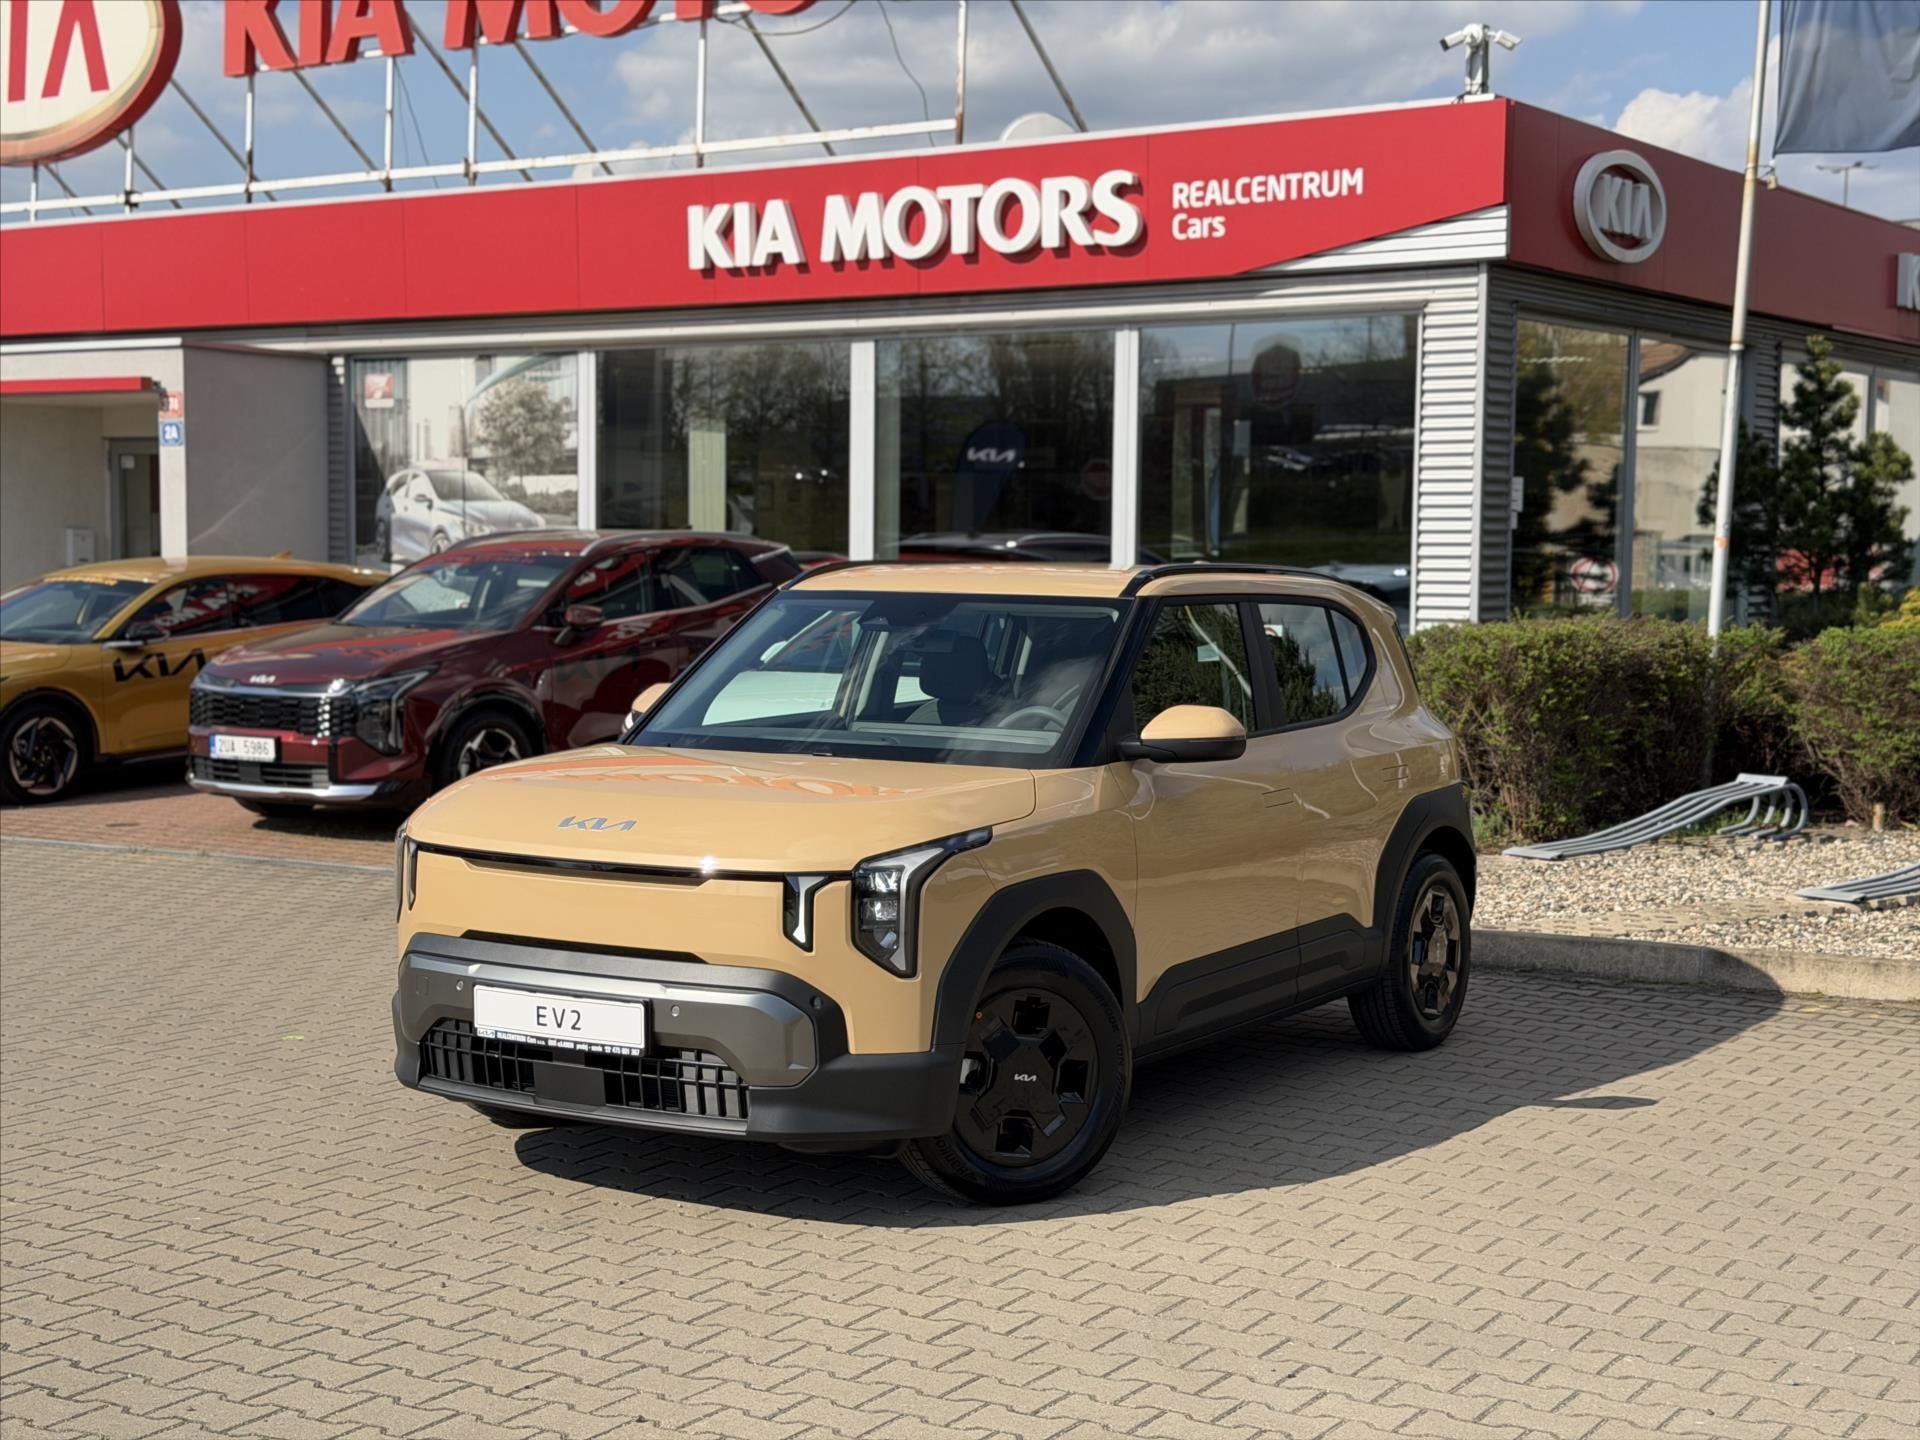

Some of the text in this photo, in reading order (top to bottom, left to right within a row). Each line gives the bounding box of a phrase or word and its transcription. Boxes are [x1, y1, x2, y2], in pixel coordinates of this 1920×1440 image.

[8, 0, 110, 103] IA
[223, 0, 414, 77] KIA
[1172, 167, 1364, 210] REALCENTRUM
[1598, 172, 1653, 240] KIA
[687, 169, 1143, 270] KIA MOTORS
[1172, 213, 1226, 240] Cars
[966, 447, 1017, 463] KIA
[112, 647, 207, 682] KIA
[558, 816, 637, 831] KIA
[536, 1005, 581, 1031] EV2
[1014, 1073, 1037, 1082] KIA
